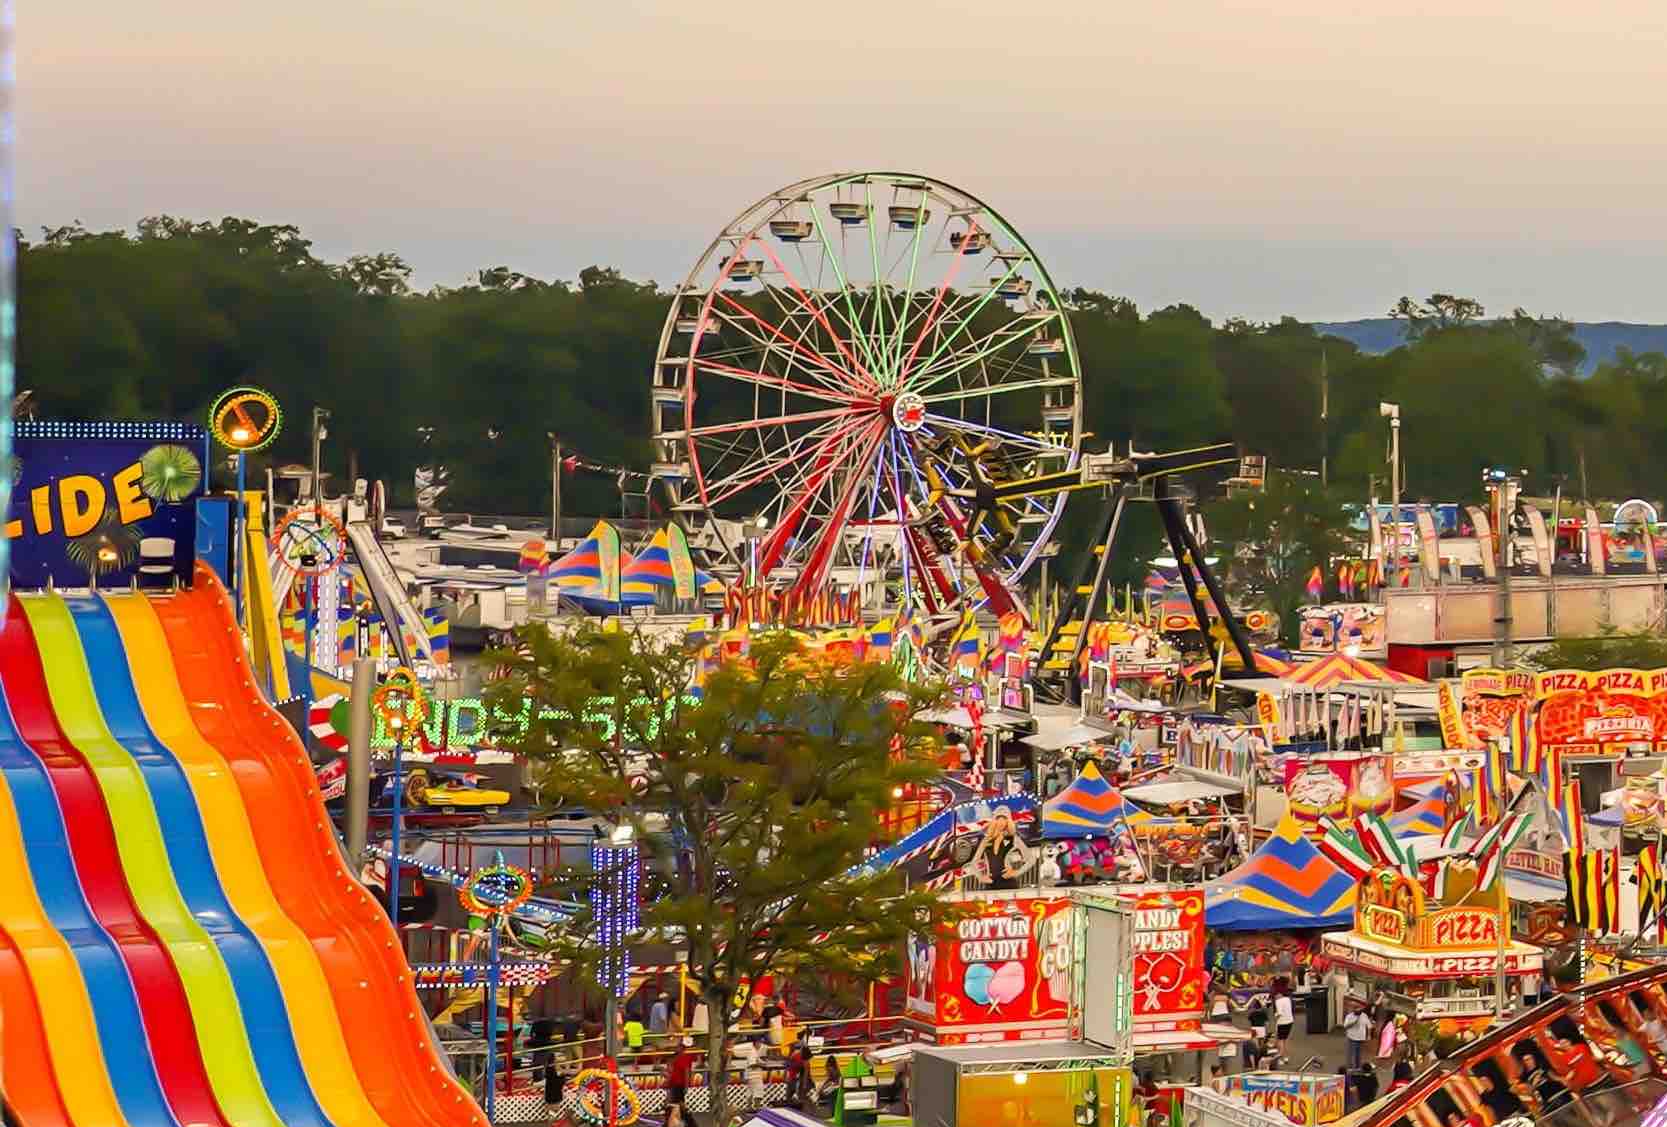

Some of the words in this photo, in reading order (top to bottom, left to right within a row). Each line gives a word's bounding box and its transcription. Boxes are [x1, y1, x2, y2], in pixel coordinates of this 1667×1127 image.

[3, 461, 153, 538] IDE
[1542, 674, 1588, 693] PIZZA
[1598, 672, 1645, 692] PIZZA
[959, 915, 1030, 939] COTTON
[1134, 908, 1182, 930] ANDY
[1436, 914, 1497, 944] PIZZA
[960, 938, 1029, 962] CANDY!
[1132, 930, 1189, 952] PPLES!
[1246, 1088, 1308, 1126] ICKETS
